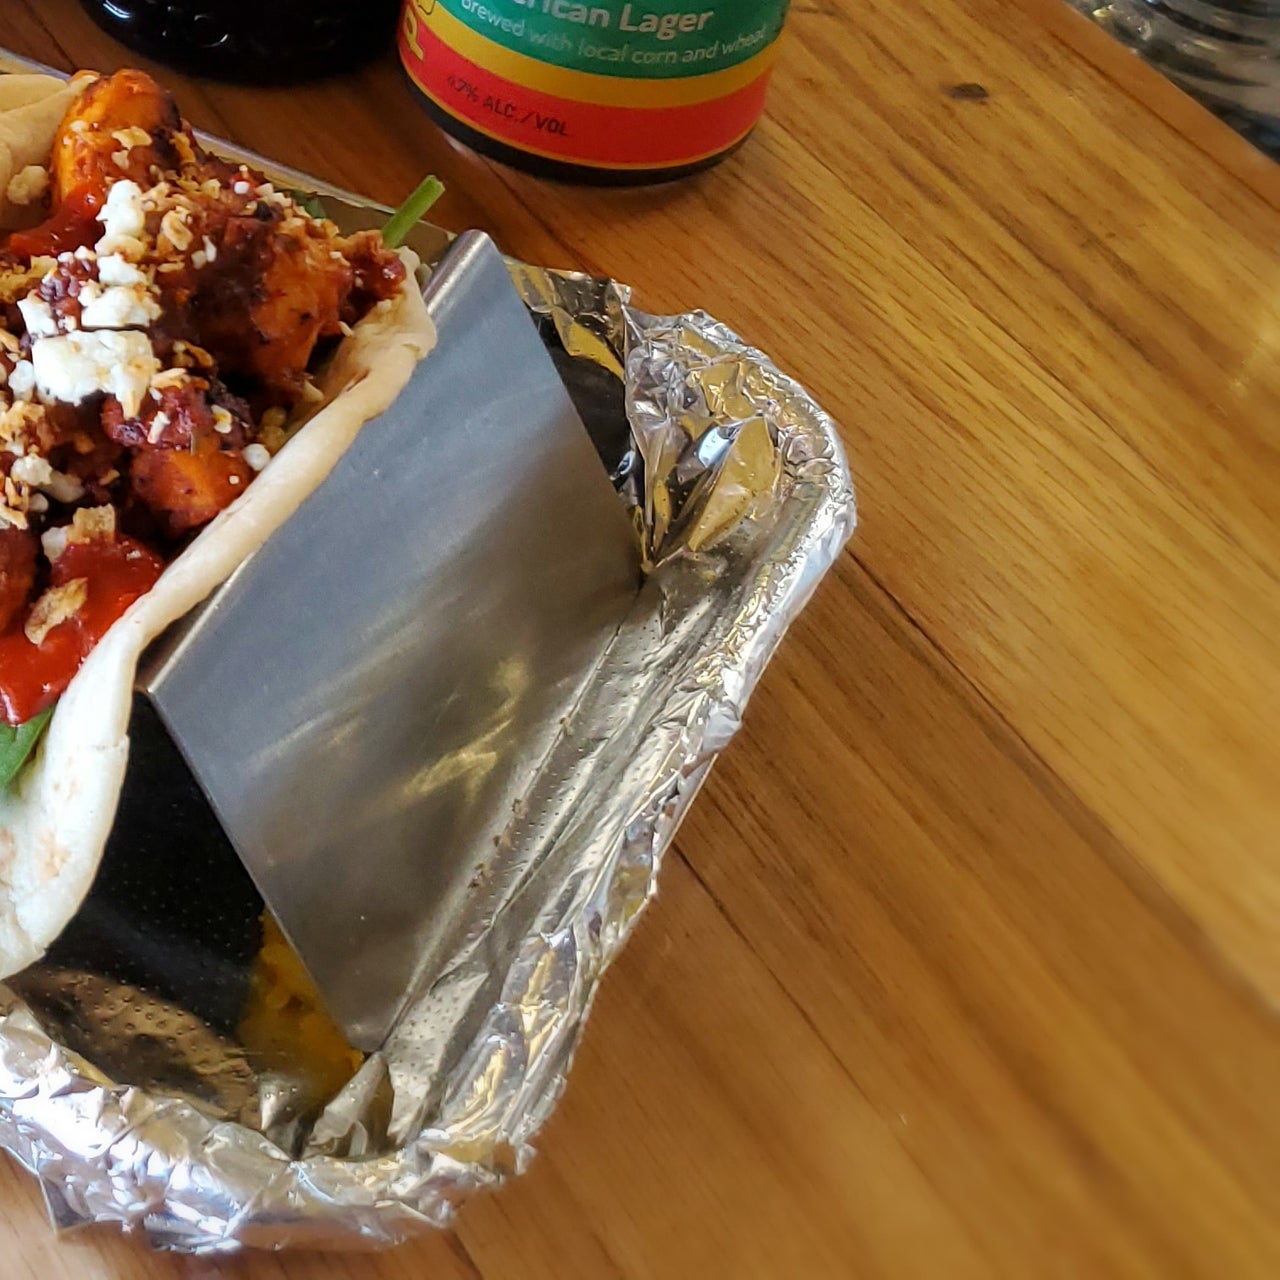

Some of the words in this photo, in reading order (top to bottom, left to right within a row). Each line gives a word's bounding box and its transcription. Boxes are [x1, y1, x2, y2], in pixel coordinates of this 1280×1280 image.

[619, 3, 714, 40] Lager
[528, 28, 573, 51] with
[578, 38, 626, 61] local
[632, 49, 677, 64] corn
[682, 41, 719, 63] and
